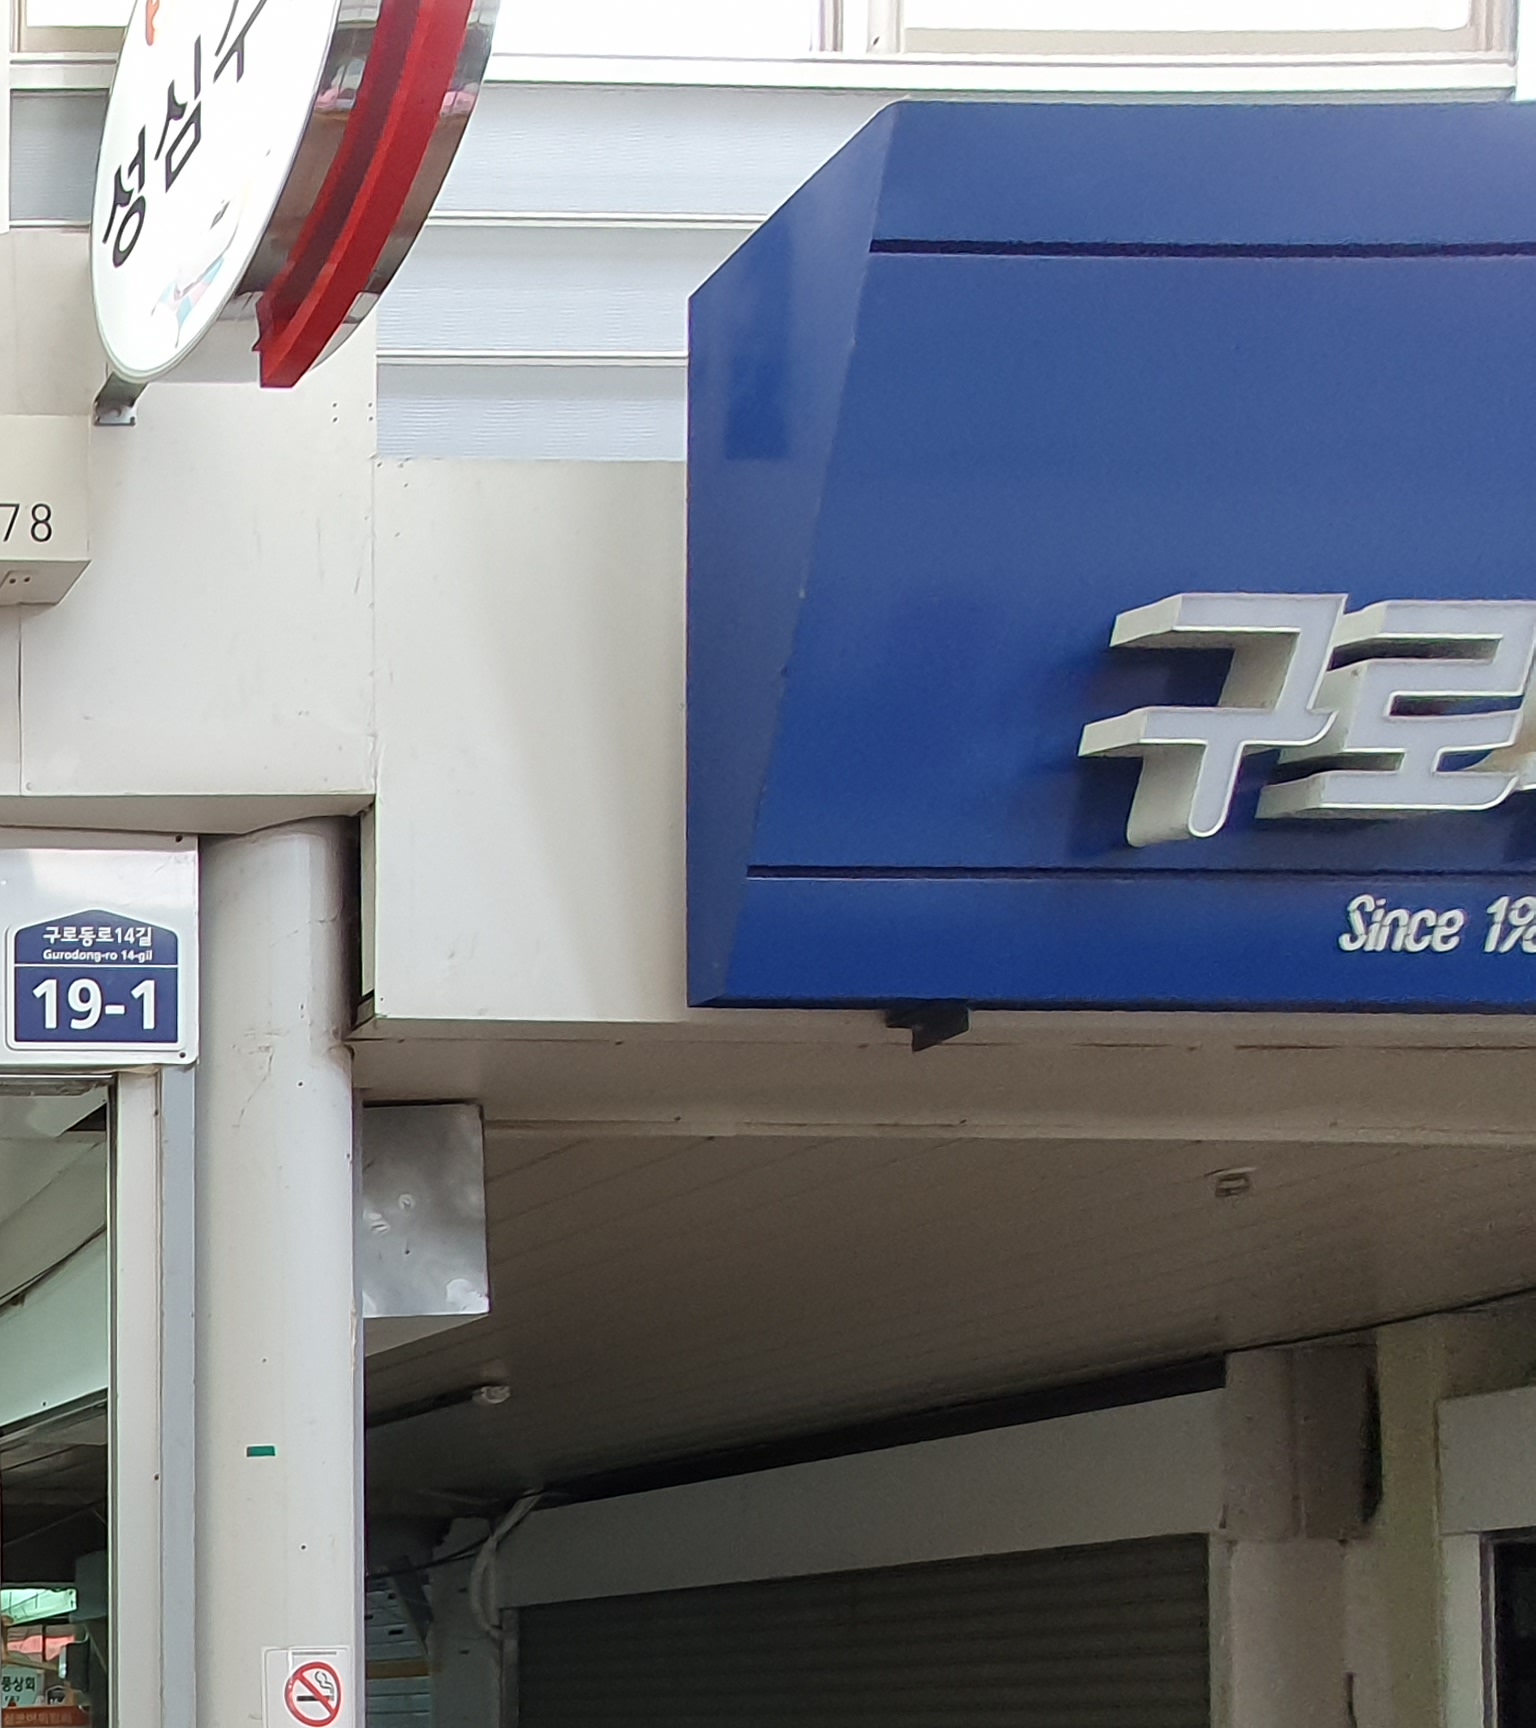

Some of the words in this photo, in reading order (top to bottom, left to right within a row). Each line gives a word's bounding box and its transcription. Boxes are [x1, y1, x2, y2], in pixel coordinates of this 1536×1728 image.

[1078, 591, 1536, 848] 구로
[42, 926, 153, 947] 구로동로14길
[1339, 893, 1465, 953] Since
[42, 948, 118, 963] Gurodong-ro
[120, 948, 153, 964] 14-gil
[32, 978, 156, 1030] 19-1
